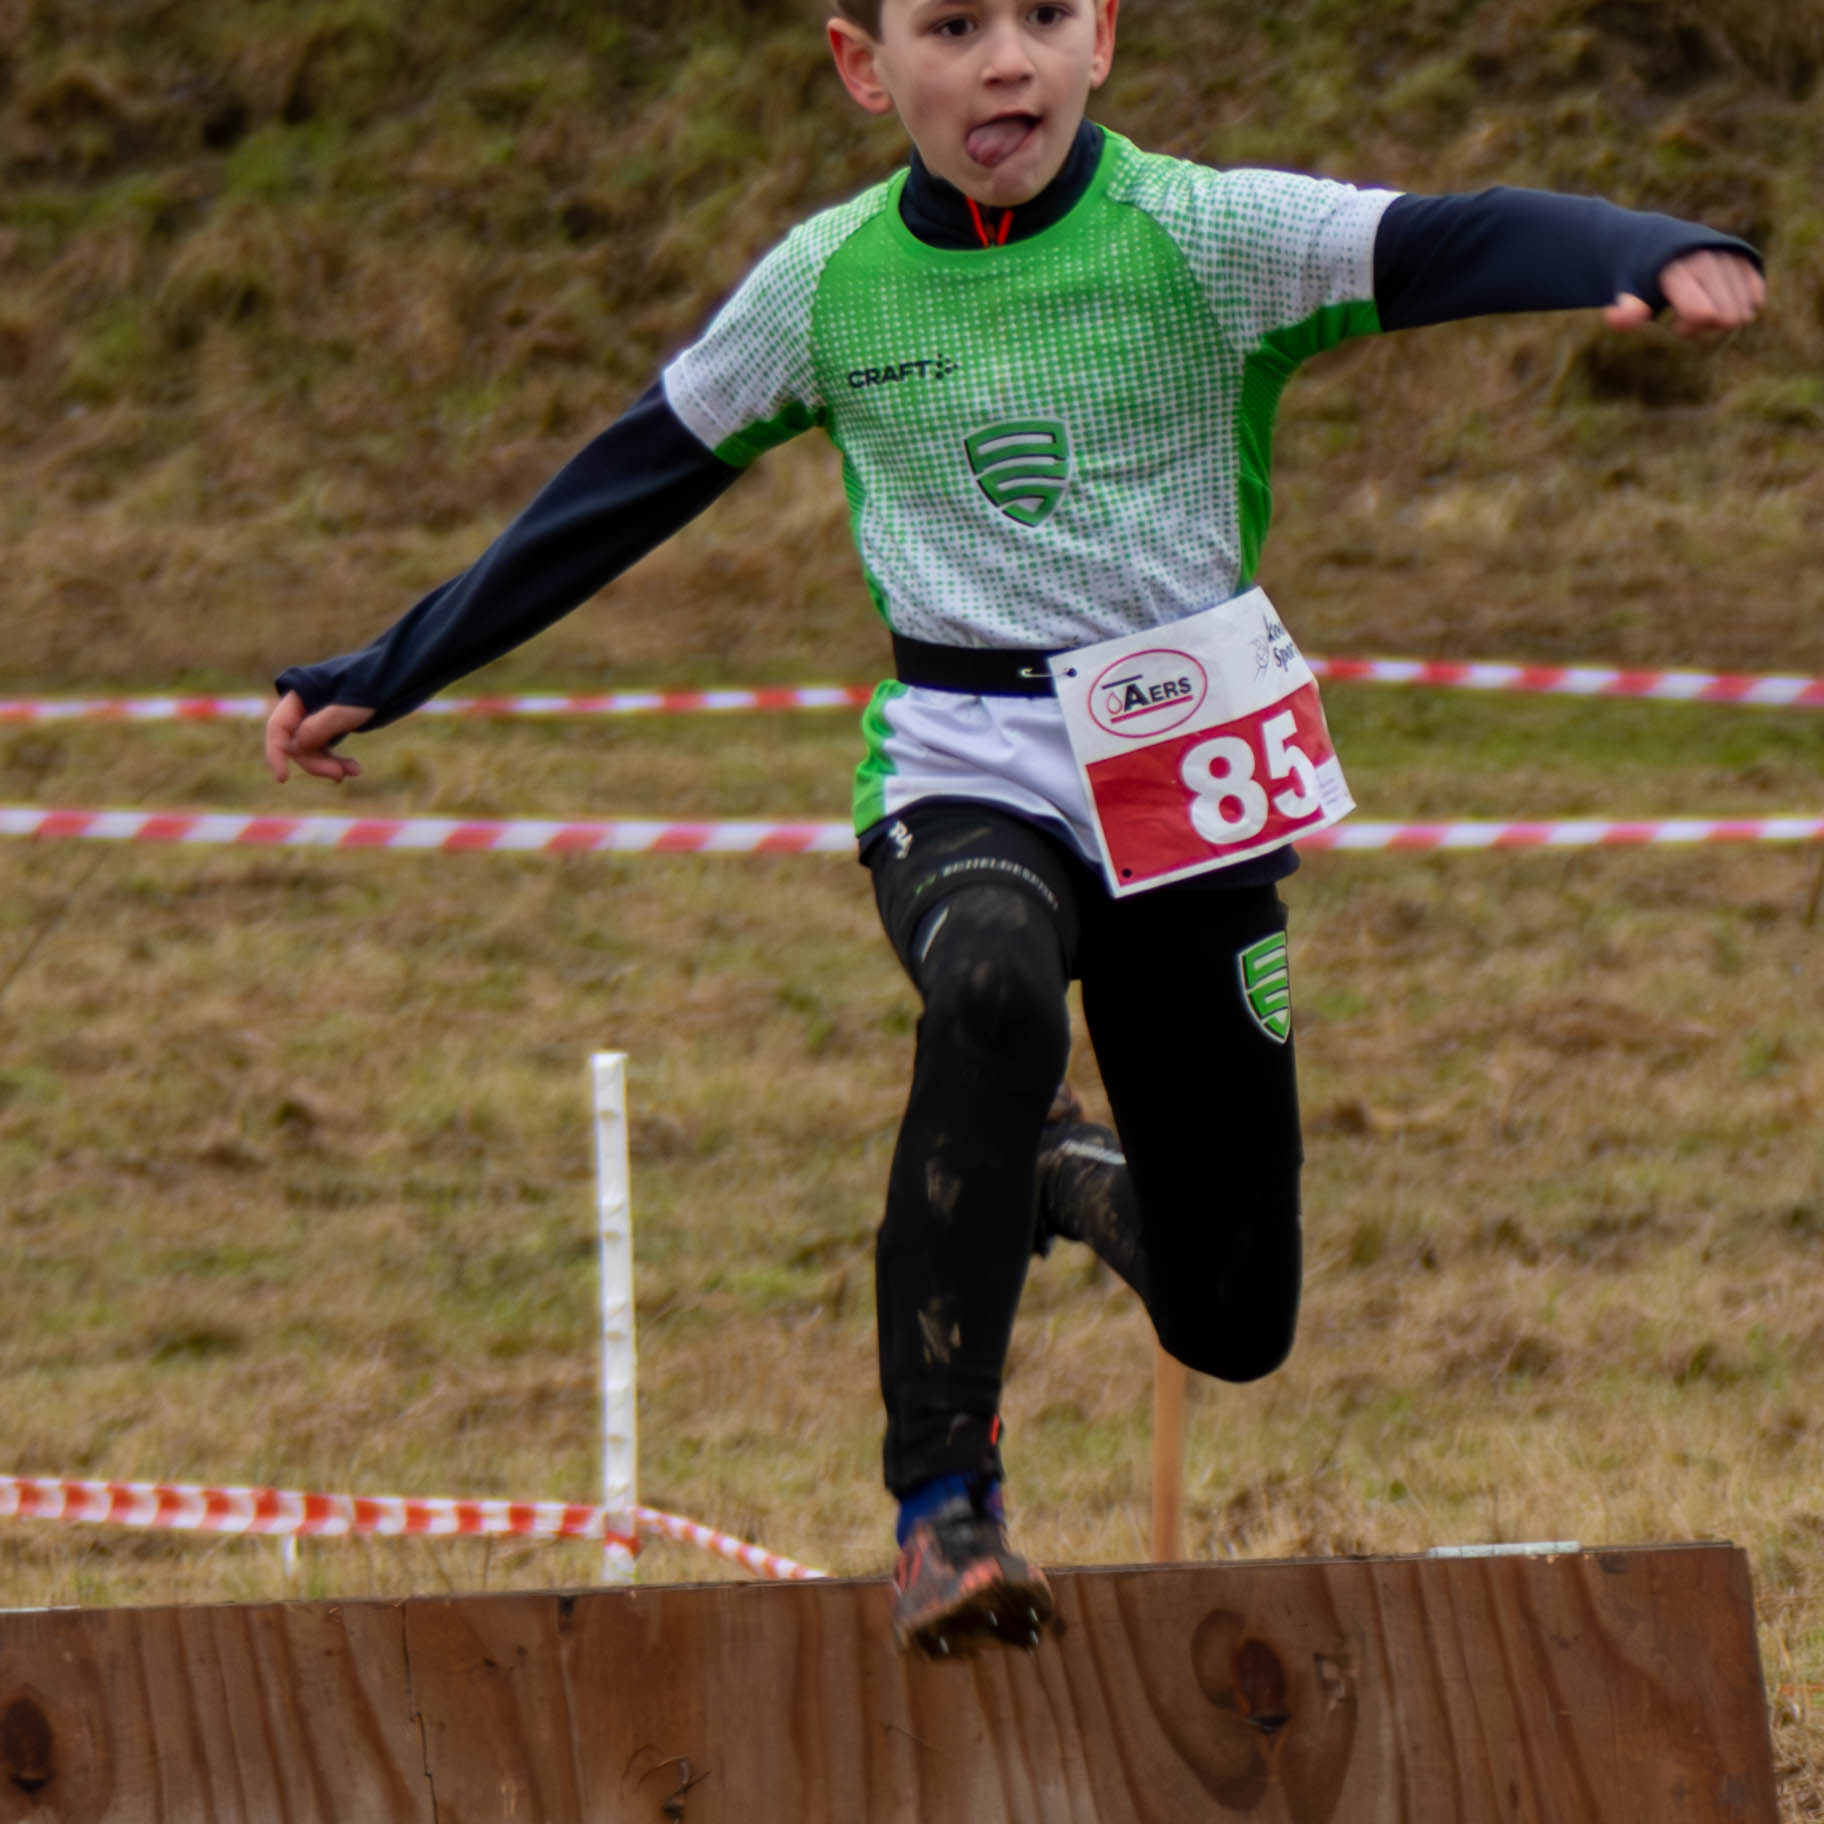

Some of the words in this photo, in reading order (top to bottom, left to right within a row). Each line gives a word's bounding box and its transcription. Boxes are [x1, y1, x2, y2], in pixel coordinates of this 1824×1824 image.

[848, 360, 935, 388] CRAFT
[1123, 677, 1192, 712] AERS
[1180, 709, 1323, 845] 85
